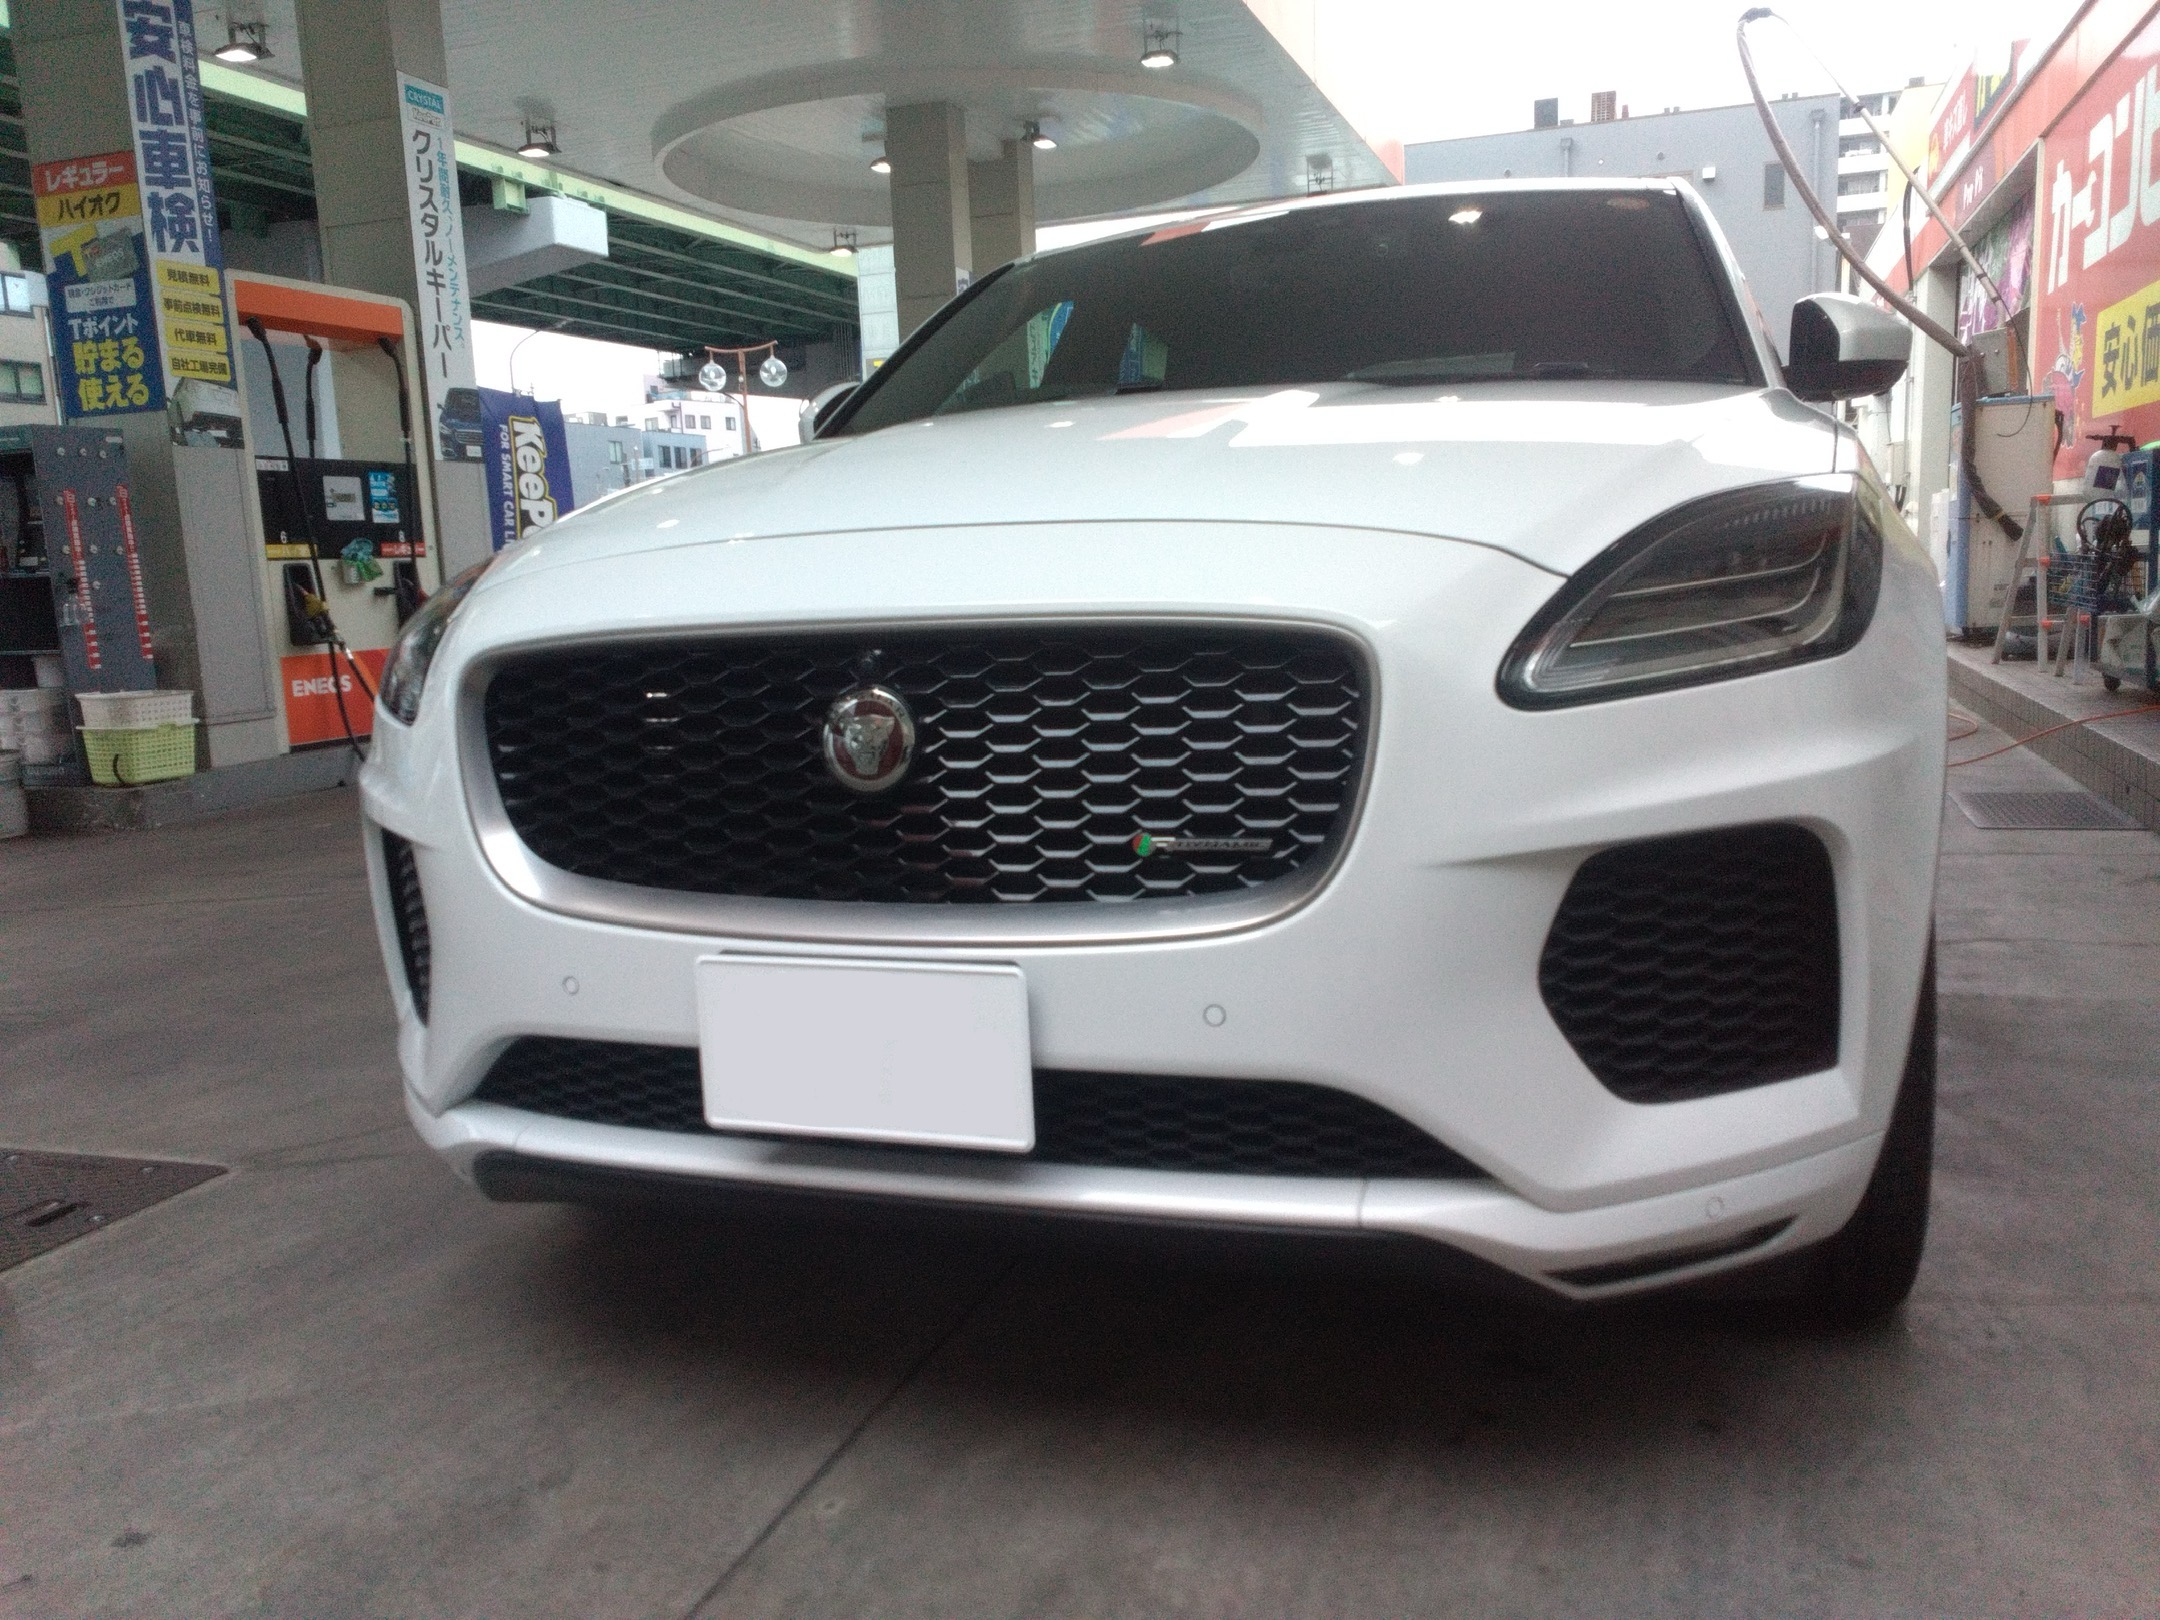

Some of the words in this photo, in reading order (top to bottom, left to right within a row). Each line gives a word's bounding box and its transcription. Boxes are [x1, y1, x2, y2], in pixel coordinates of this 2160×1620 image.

[122, 0, 200, 252] 安心車検
[45, 161, 124, 192] レギュラー
[59, 192, 120, 221] ハイオク
[412, 129, 452, 378] クリスタルキーパー
[166, 268, 211, 287] 見積無料
[68, 312, 138, 340] Tポイント
[174, 327, 217, 346] 代車無料
[72, 336, 145, 375] 貯まる
[78, 373, 149, 412] 使える
[499, 425, 508, 449] FOR
[501, 453, 513, 497] SMART
[503, 503, 515, 526] CAR
